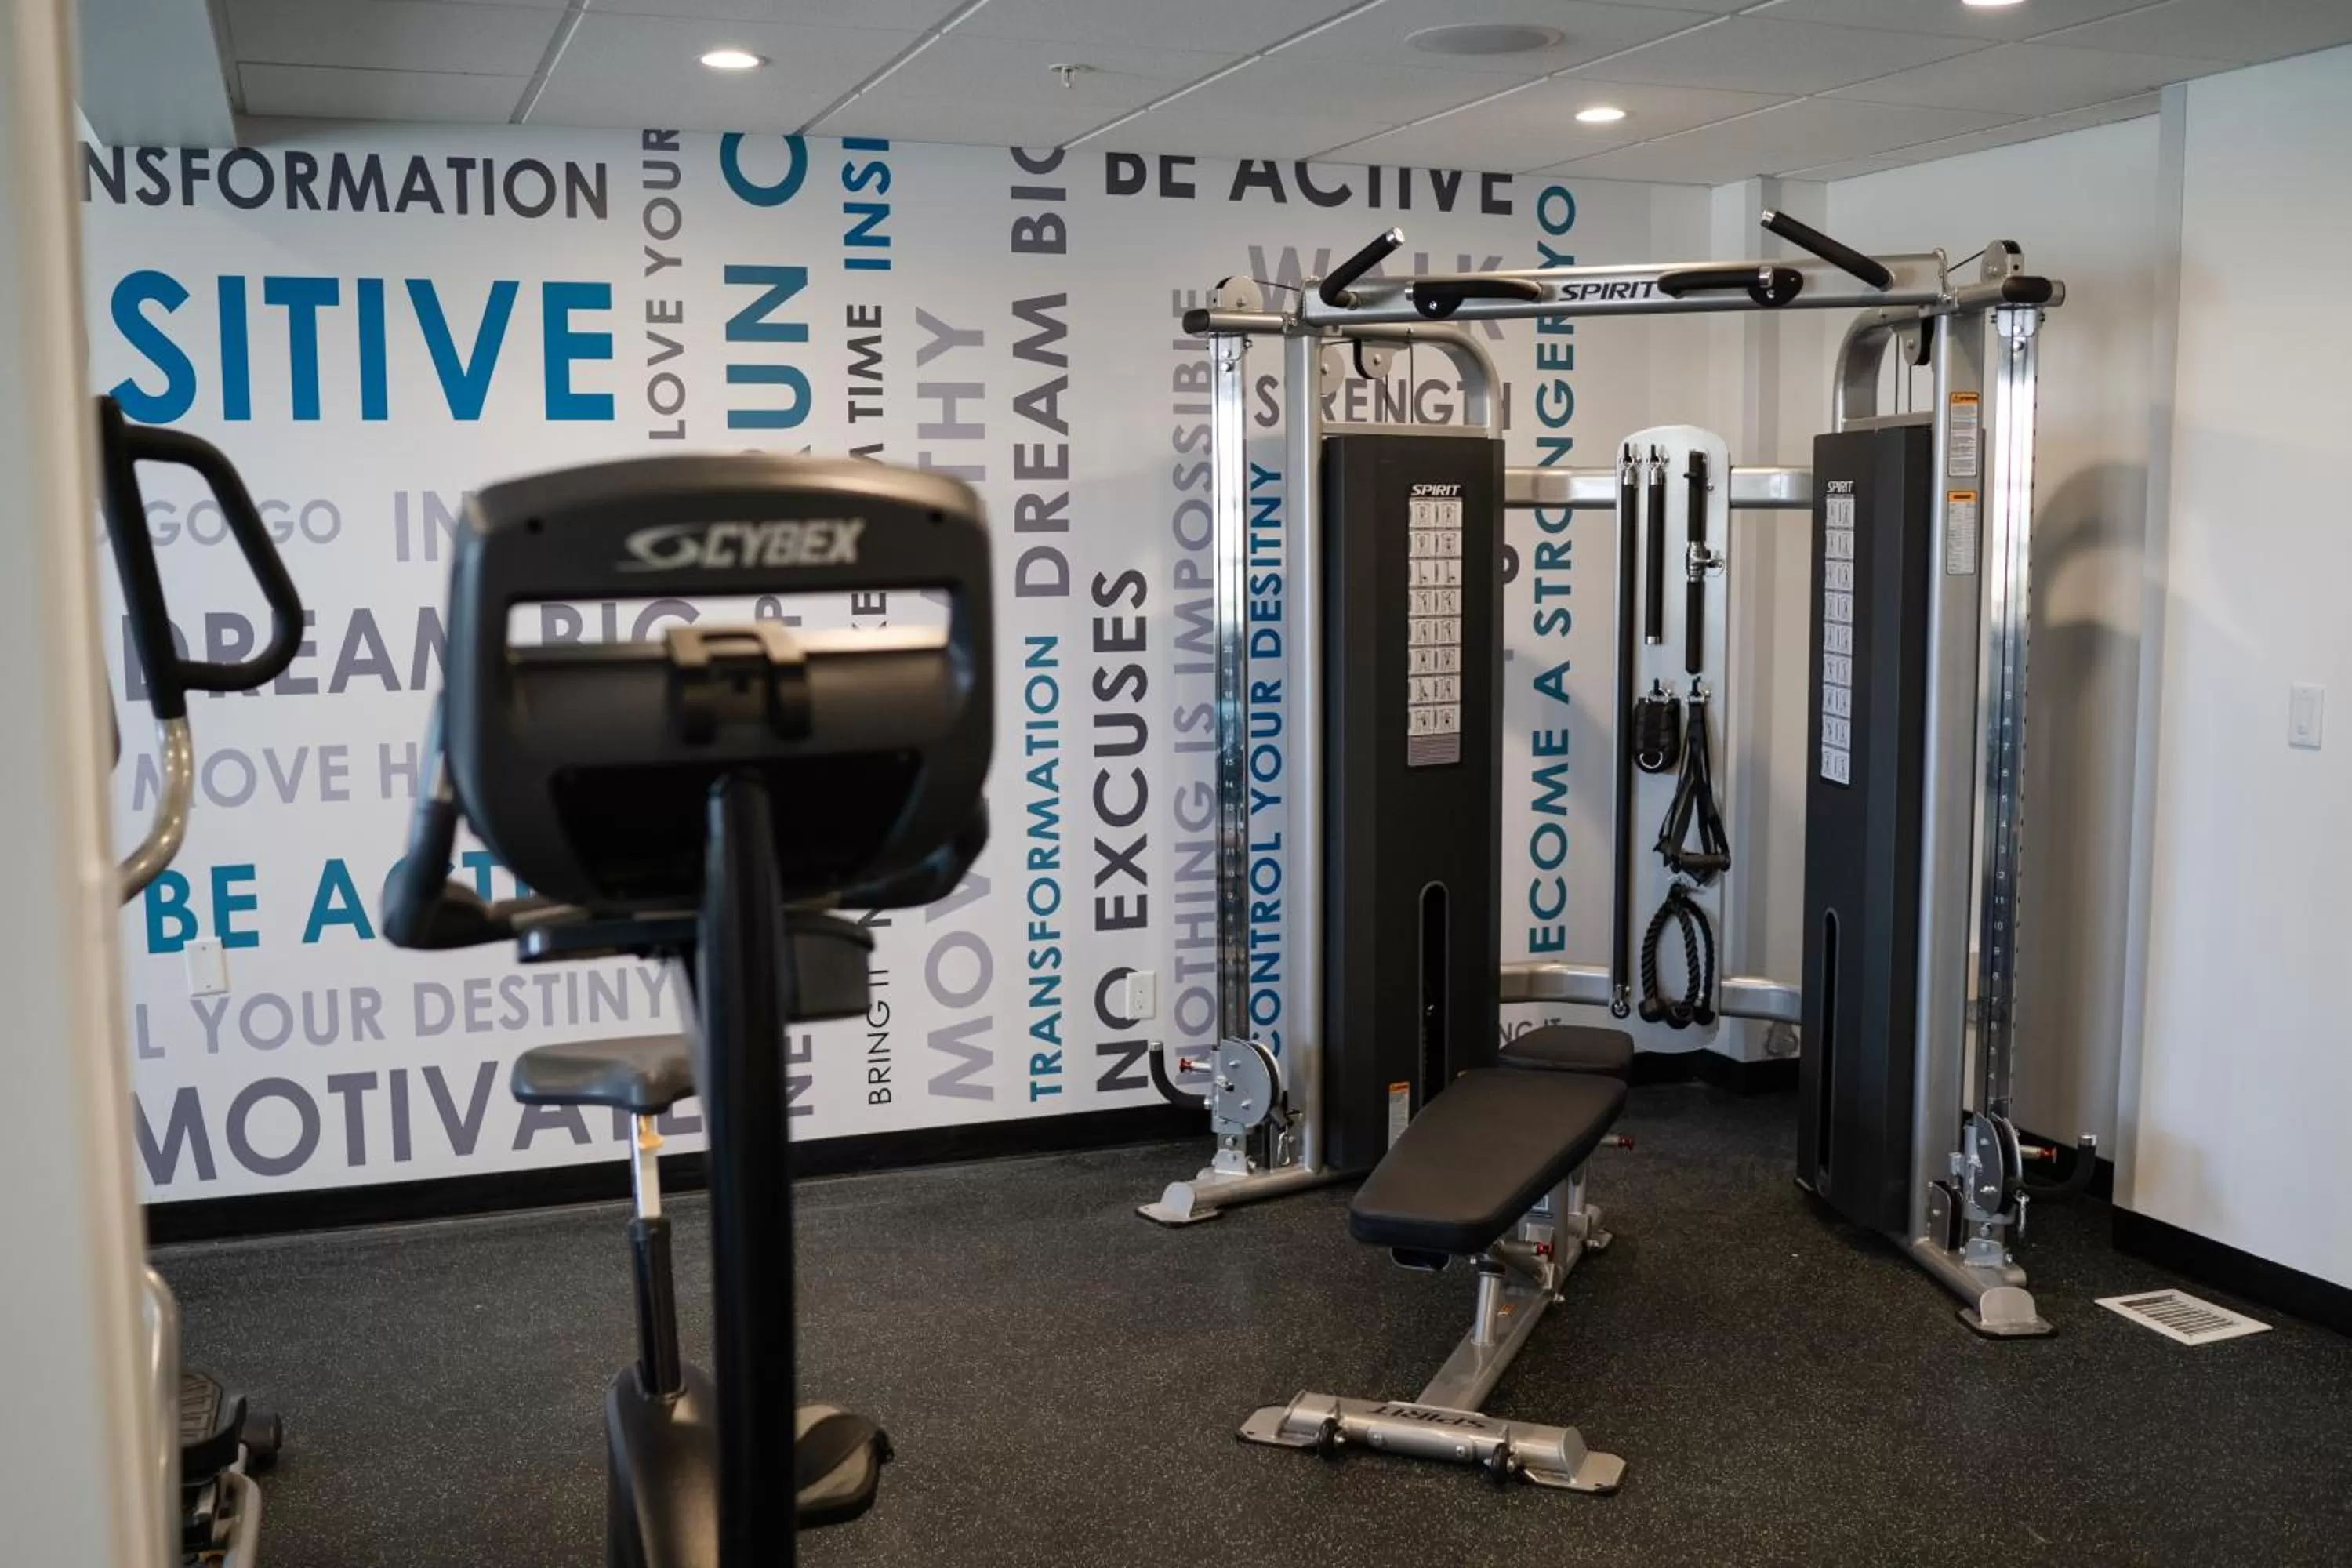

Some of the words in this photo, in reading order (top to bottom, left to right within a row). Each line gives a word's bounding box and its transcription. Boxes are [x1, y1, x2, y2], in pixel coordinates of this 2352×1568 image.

[642, 129, 683, 276] YOUR
[109, 269, 615, 424] SITIVE
[1558, 280, 1659, 302] SPIRIT
[645, 299, 686, 439] LOVE
[724, 264, 812, 454] UN
[846, 304, 884, 423] TIME
[1012, 292, 1070, 597] DREAM
[1411, 484, 1461, 496] SPIRIT
[1826, 481, 1854, 493] SPIRIT
[702, 517, 866, 569] CYBEX
[1250, 463, 1282, 659] DESITNY
[1174, 702, 1214, 753] IS
[1533, 661, 1571, 706] A
[1091, 568, 1149, 931] EXCUSES
[1250, 680, 1282, 815] YOUR
[145, 863, 260, 953] BE
[1025, 636, 1062, 1101] TRANSFORMATION
[191, 986, 386, 1054] YOUR
[414, 966, 670, 1036] DESTINY
[867, 1000, 891, 1105] BRING
[1094, 967, 1149, 1092] NO
